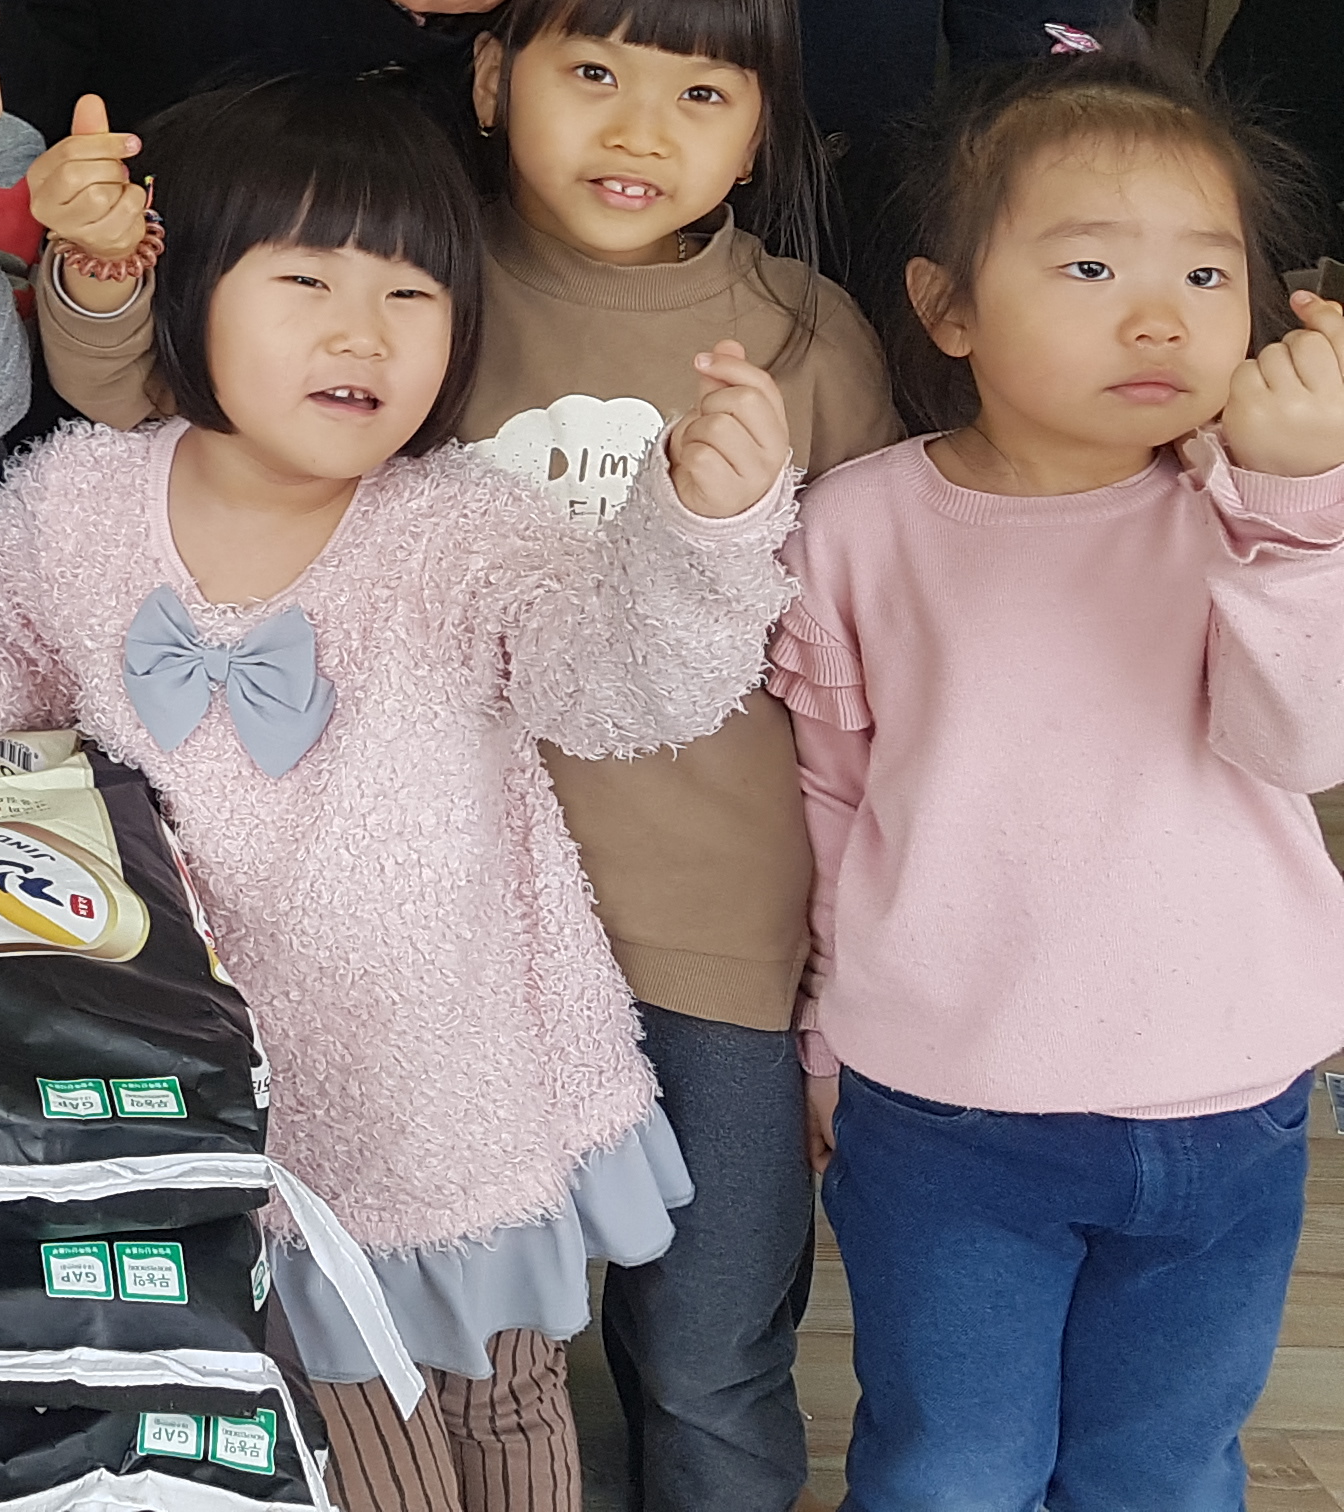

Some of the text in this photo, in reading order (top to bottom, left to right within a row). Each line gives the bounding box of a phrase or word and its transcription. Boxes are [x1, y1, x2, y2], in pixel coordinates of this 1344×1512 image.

[58, 1100, 94, 1110] GAP
[130, 1098, 169, 1108] 무농약
[61, 1271, 97, 1283] GAP
[133, 1273, 171, 1288] 무농약
[152, 1428, 189, 1444] GAP
[224, 1438, 261, 1457] 무농약
